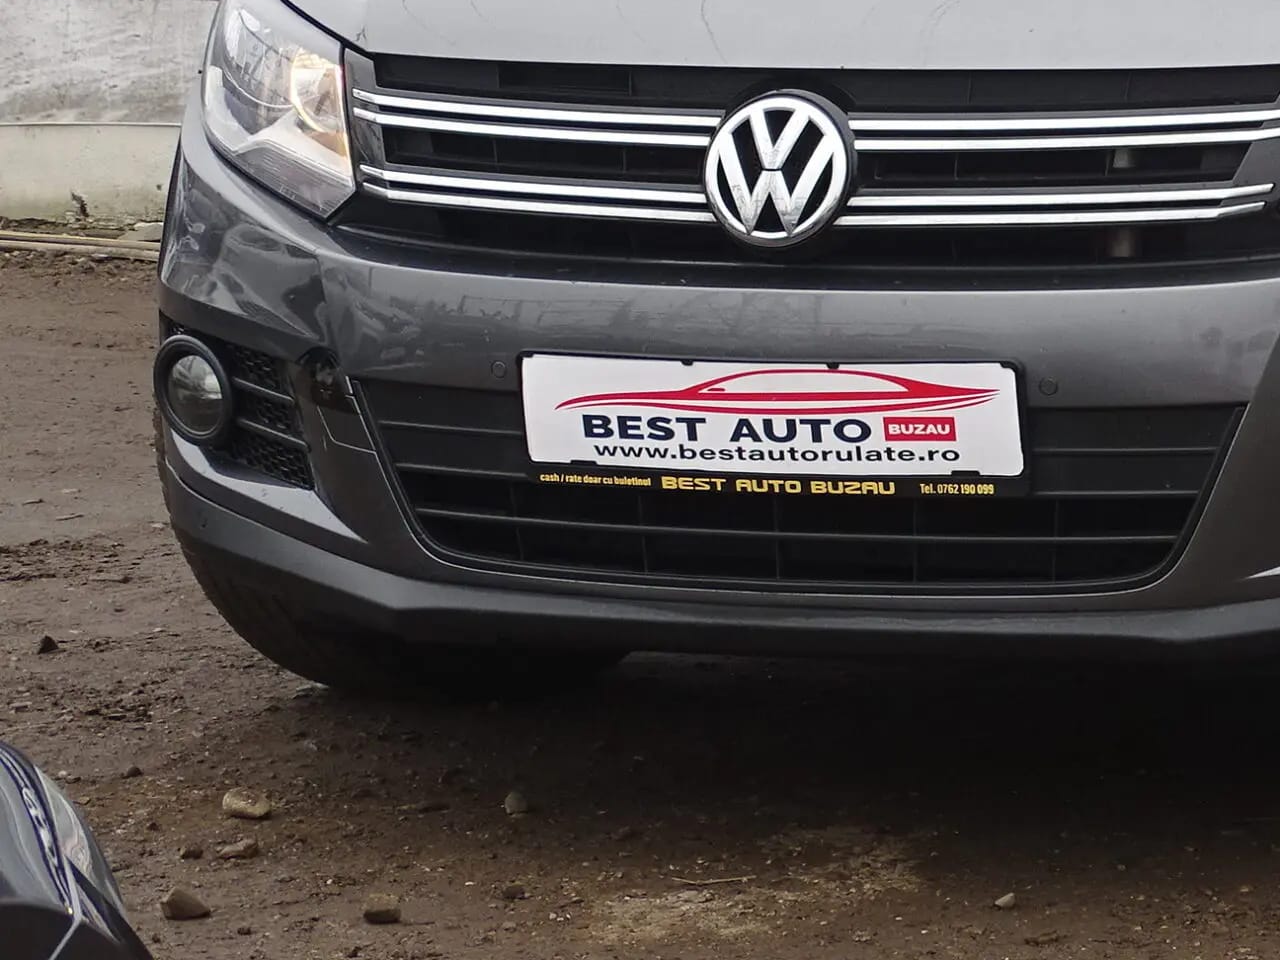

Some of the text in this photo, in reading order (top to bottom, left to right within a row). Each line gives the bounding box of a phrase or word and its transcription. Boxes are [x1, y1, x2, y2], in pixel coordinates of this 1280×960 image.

[582, 414, 951, 443] BEST AUTO BUZAU
[593, 444, 960, 462] www.bestautorulate.ro
[539, 473, 560, 482] cash
[565, 475, 582, 483] rate
[660, 476, 727, 491] BEST
[736, 478, 802, 493] AUTO
[810, 480, 896, 495] BUZAU
[920, 483, 936, 494] Tel.
[937, 483, 959, 495] 0762
[960, 484, 976, 495] 190
[976, 484, 994, 495] 099
